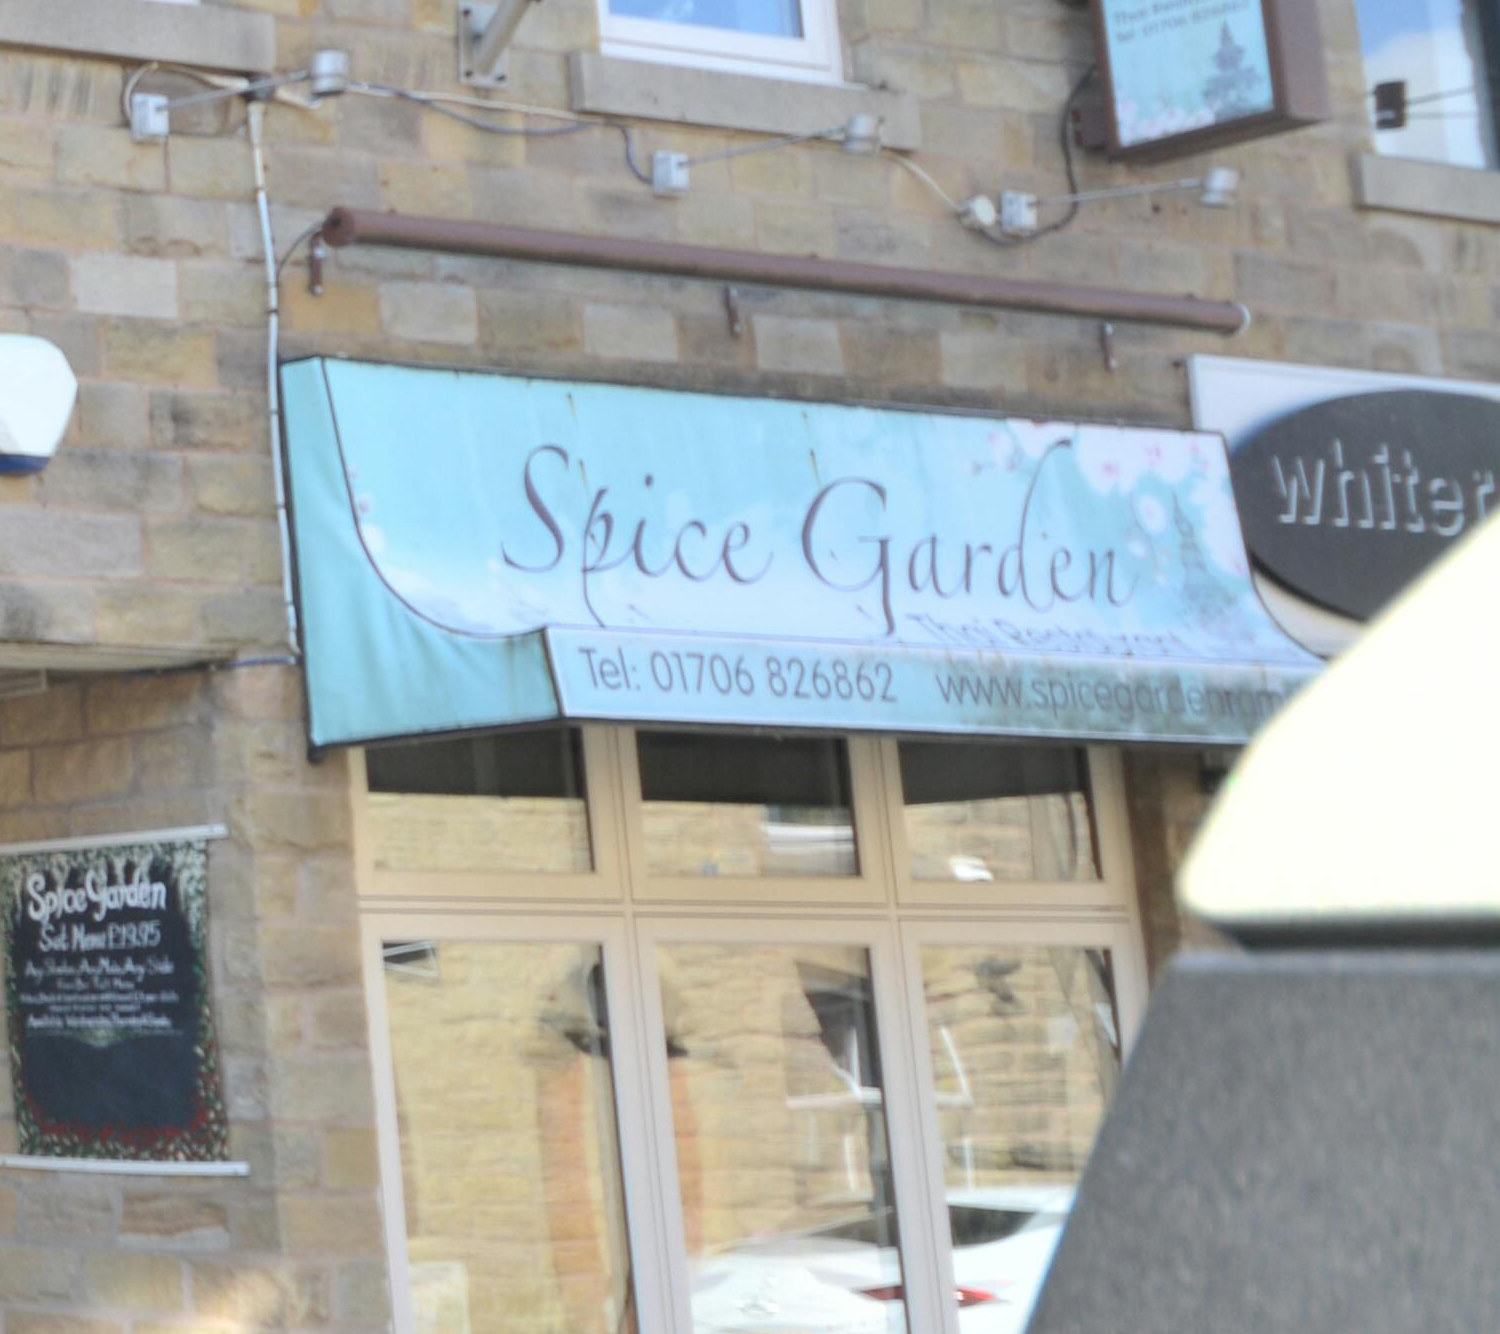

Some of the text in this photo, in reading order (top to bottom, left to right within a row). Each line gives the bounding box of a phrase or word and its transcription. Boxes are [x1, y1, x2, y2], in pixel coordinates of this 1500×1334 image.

[501, 438, 1140, 637] Spice Garden
[578, 646, 642, 692] Tel:
[650, 651, 755, 696] 01706
[765, 655, 898, 703] 826862
[85, 868, 167, 922] Garden
